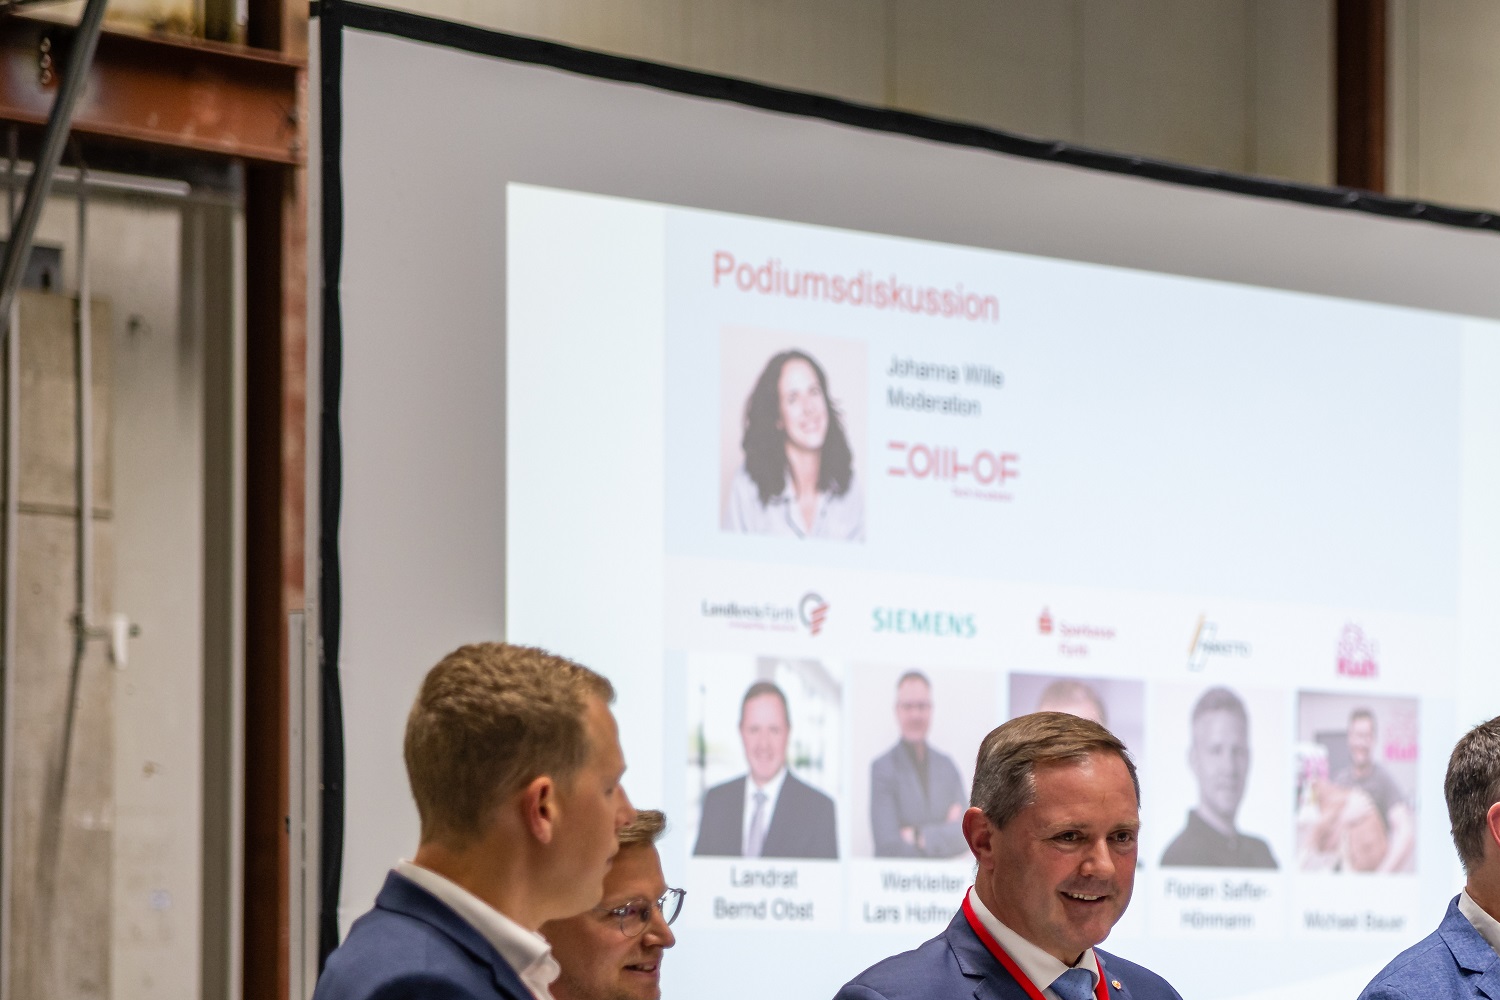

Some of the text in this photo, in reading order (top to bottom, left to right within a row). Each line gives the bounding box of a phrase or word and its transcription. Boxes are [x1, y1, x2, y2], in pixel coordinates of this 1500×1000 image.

[713, 250, 999, 322] Podiumsdiskussion
[888, 355, 1004, 389] Johanna Wille
[887, 385, 982, 417] Moderation
[872, 606, 977, 638] SIEMENS
[730, 865, 798, 889] Landrat
[1163, 877, 1216, 900] Florian
[713, 897, 814, 921] Bernd Obst
[863, 901, 901, 924] Lars
